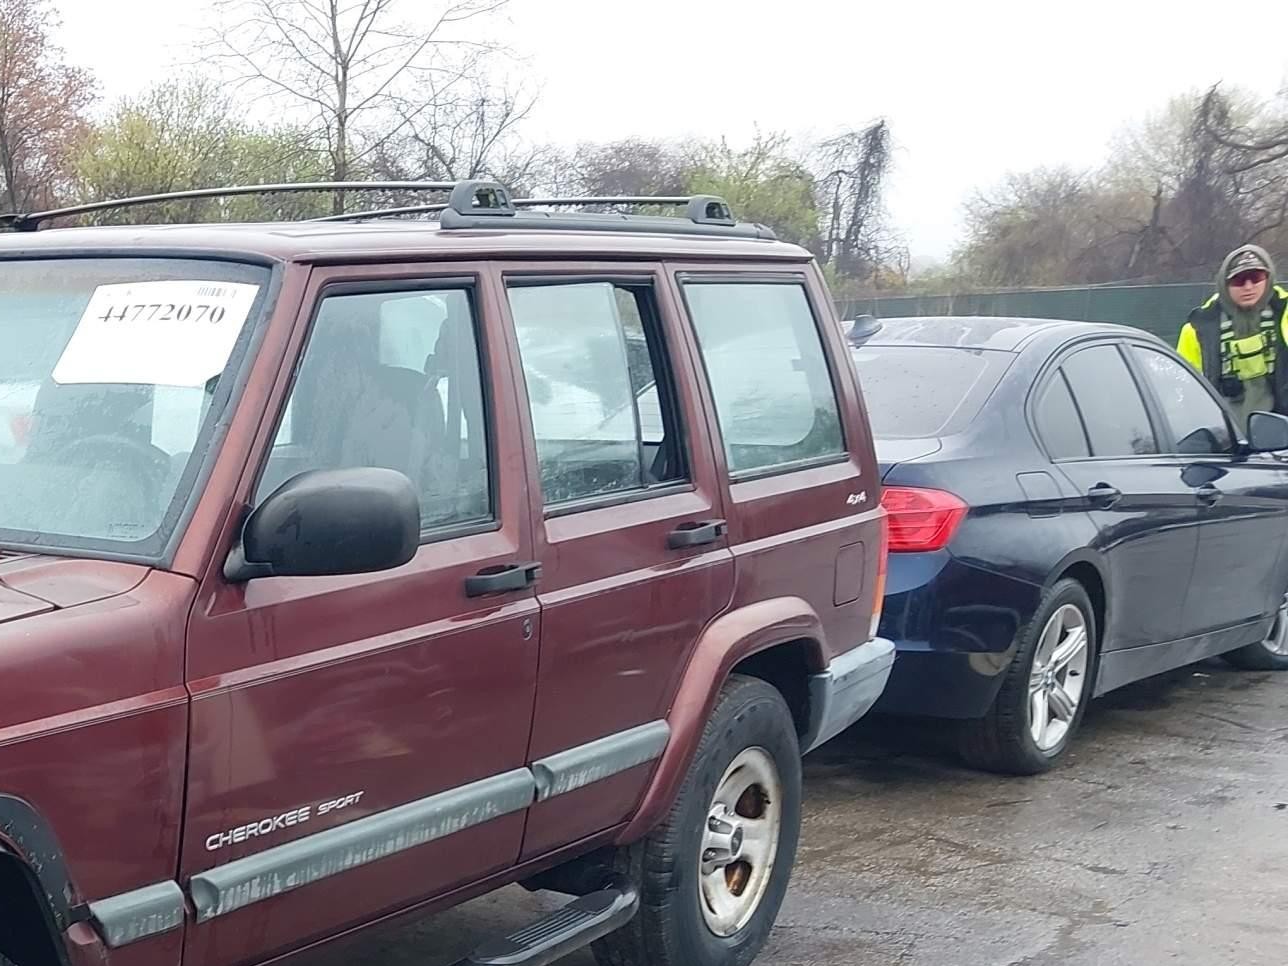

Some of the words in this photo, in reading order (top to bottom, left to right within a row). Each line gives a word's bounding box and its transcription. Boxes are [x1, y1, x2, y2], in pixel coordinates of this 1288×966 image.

[98, 303, 226, 324] 44772070
[206, 805, 312, 851] CHEROKEE
[316, 790, 365, 816] SPORT
